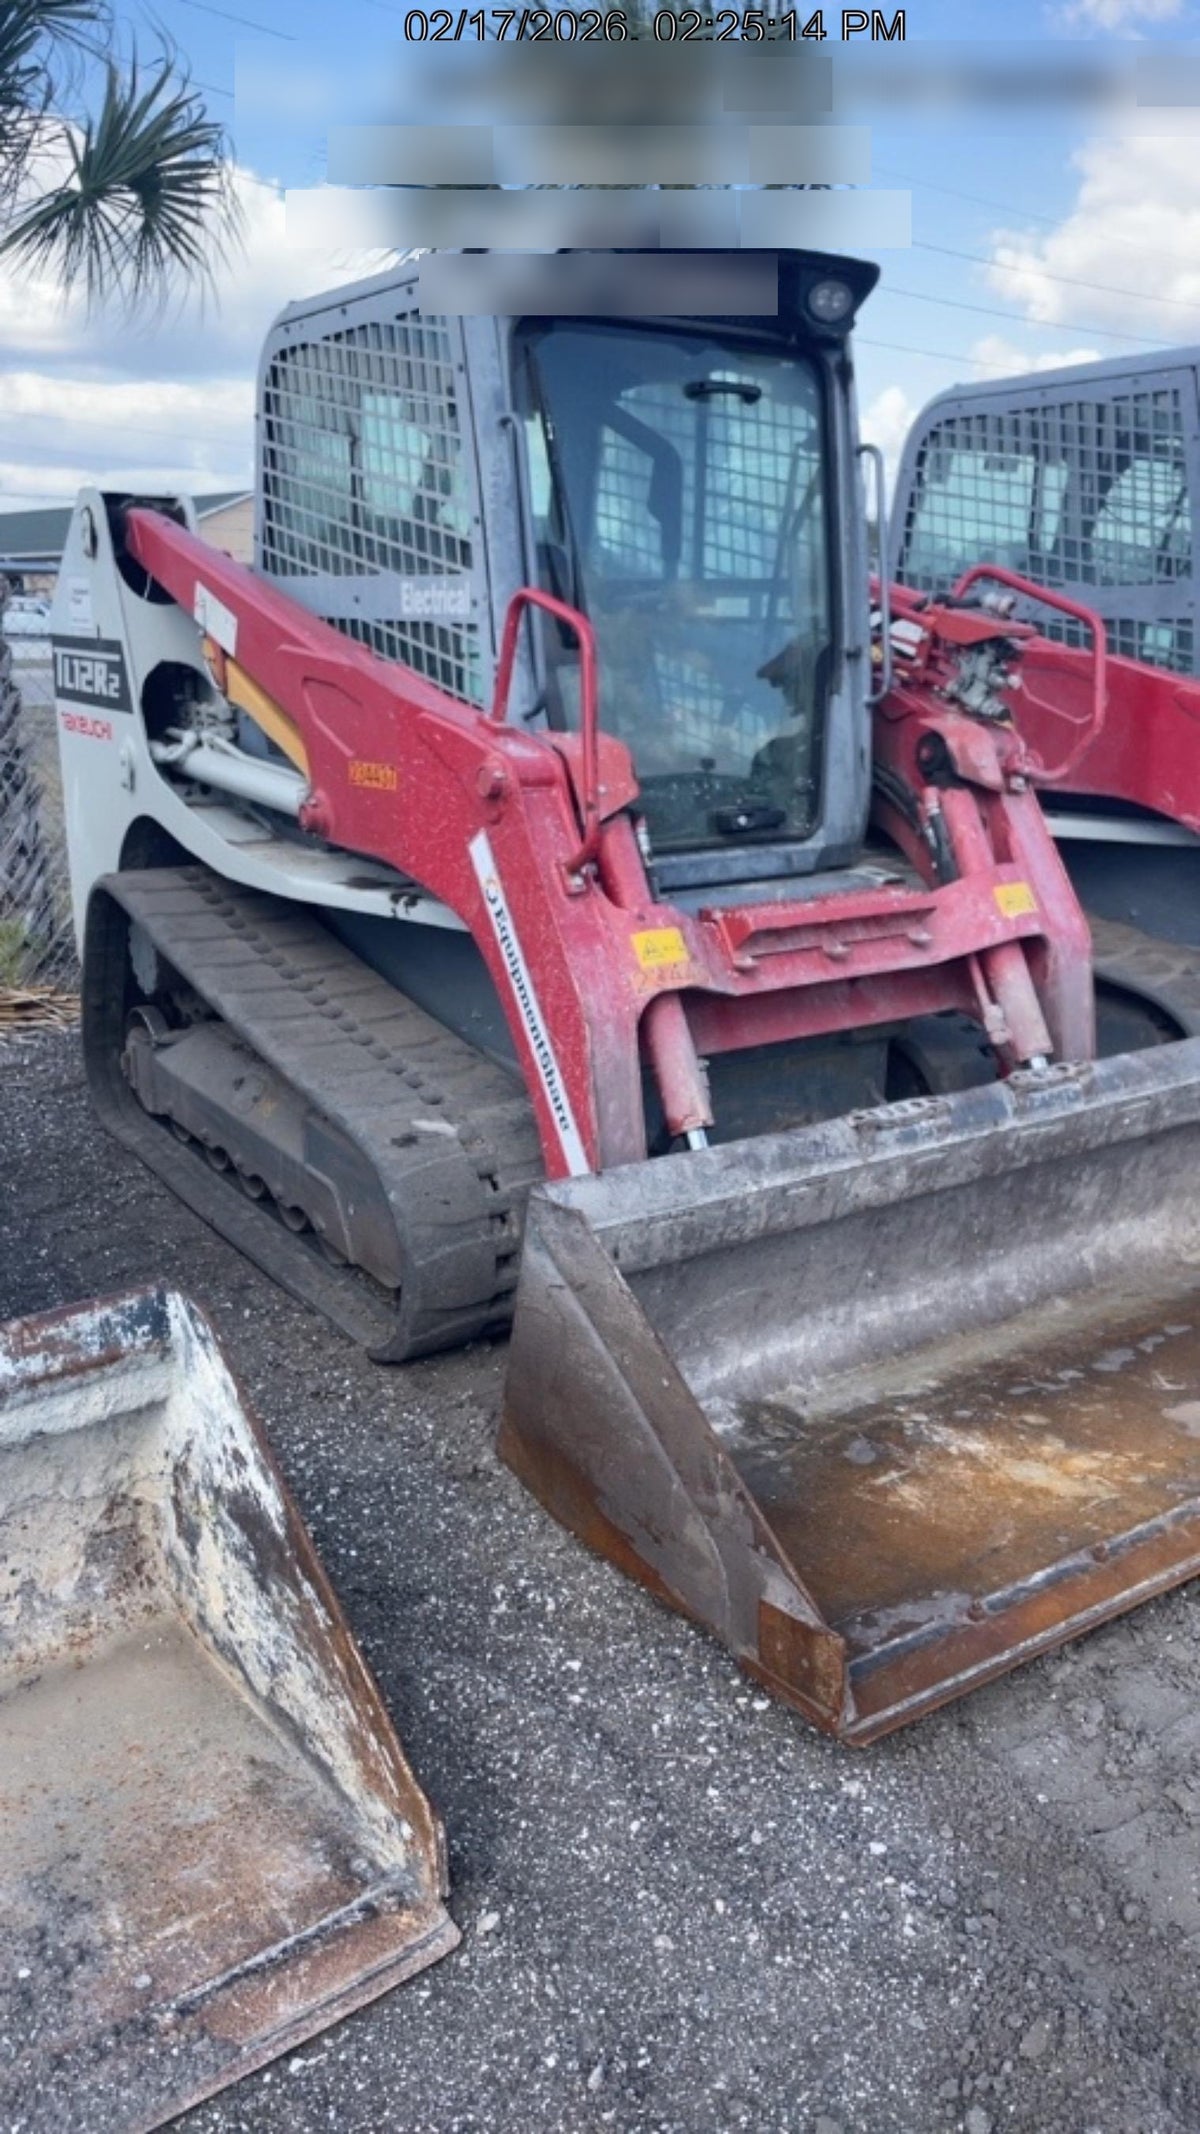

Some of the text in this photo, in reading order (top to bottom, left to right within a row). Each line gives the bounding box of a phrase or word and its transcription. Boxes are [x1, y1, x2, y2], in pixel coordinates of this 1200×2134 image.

[400, 580, 471, 614] Electrical
[53, 646, 120, 699] TL12R2
[492, 910, 570, 1133] EquipmentShare
